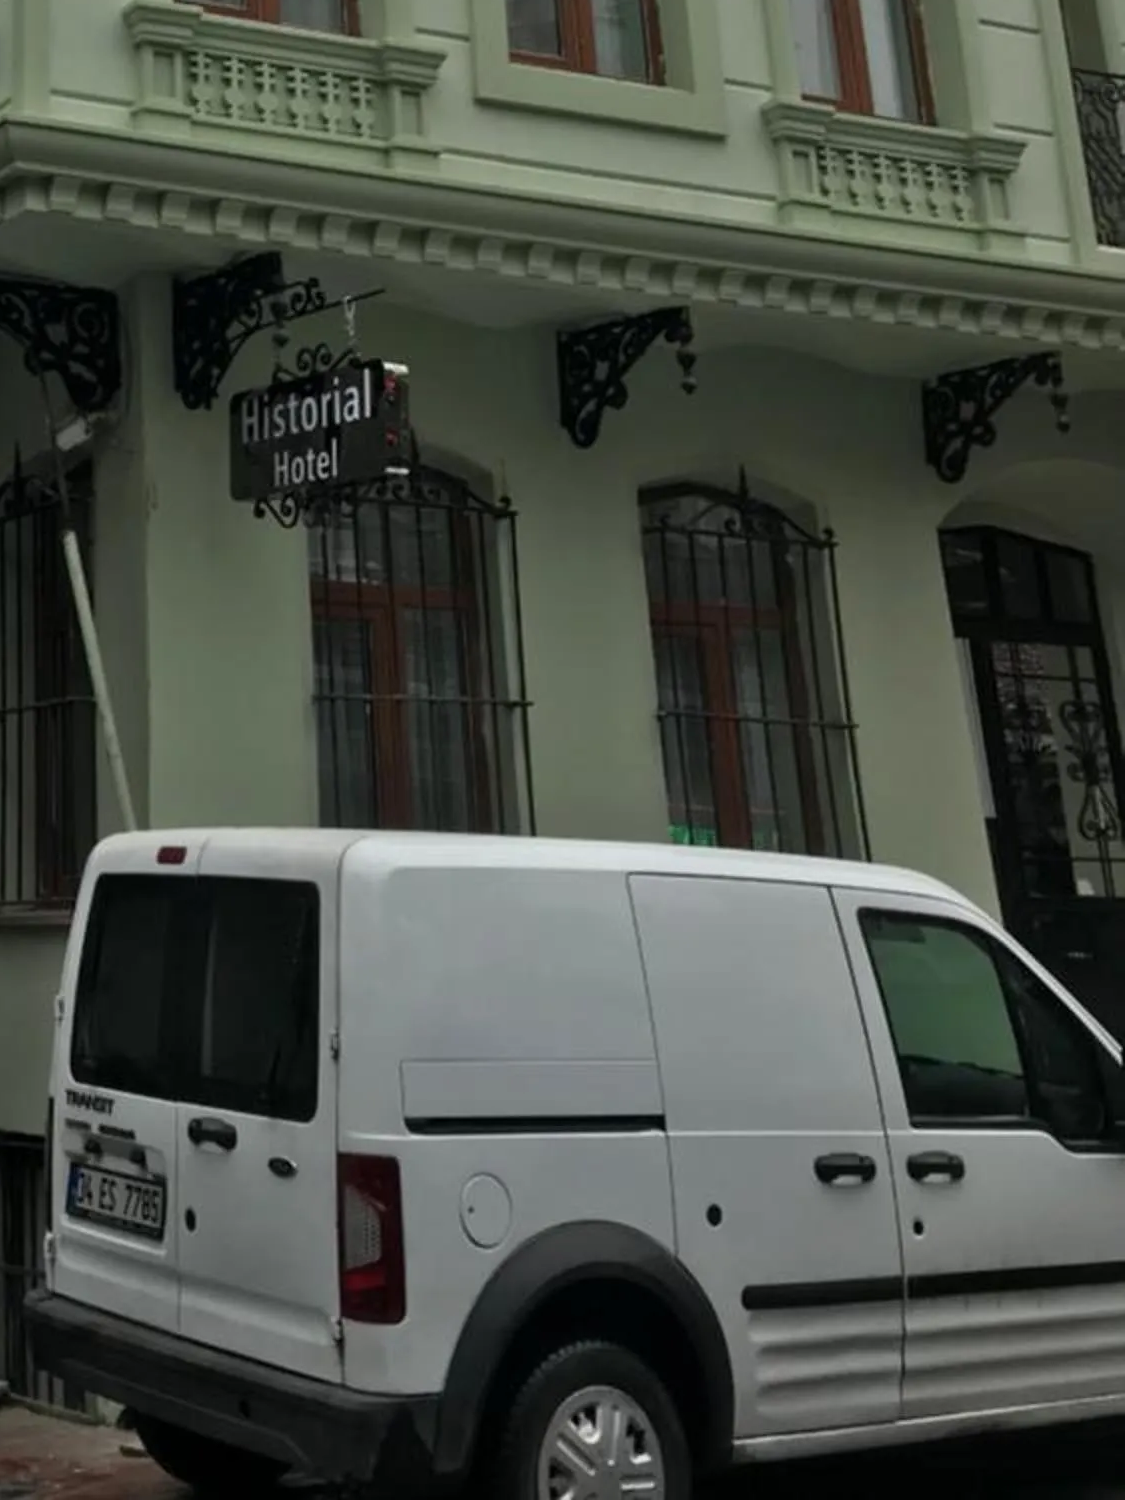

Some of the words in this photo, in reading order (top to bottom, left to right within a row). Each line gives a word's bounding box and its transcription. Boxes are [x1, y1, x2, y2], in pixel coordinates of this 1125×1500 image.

[241, 368, 372, 444] Historial
[274, 437, 338, 487] Hotel
[97, 1177, 118, 1213] ES
